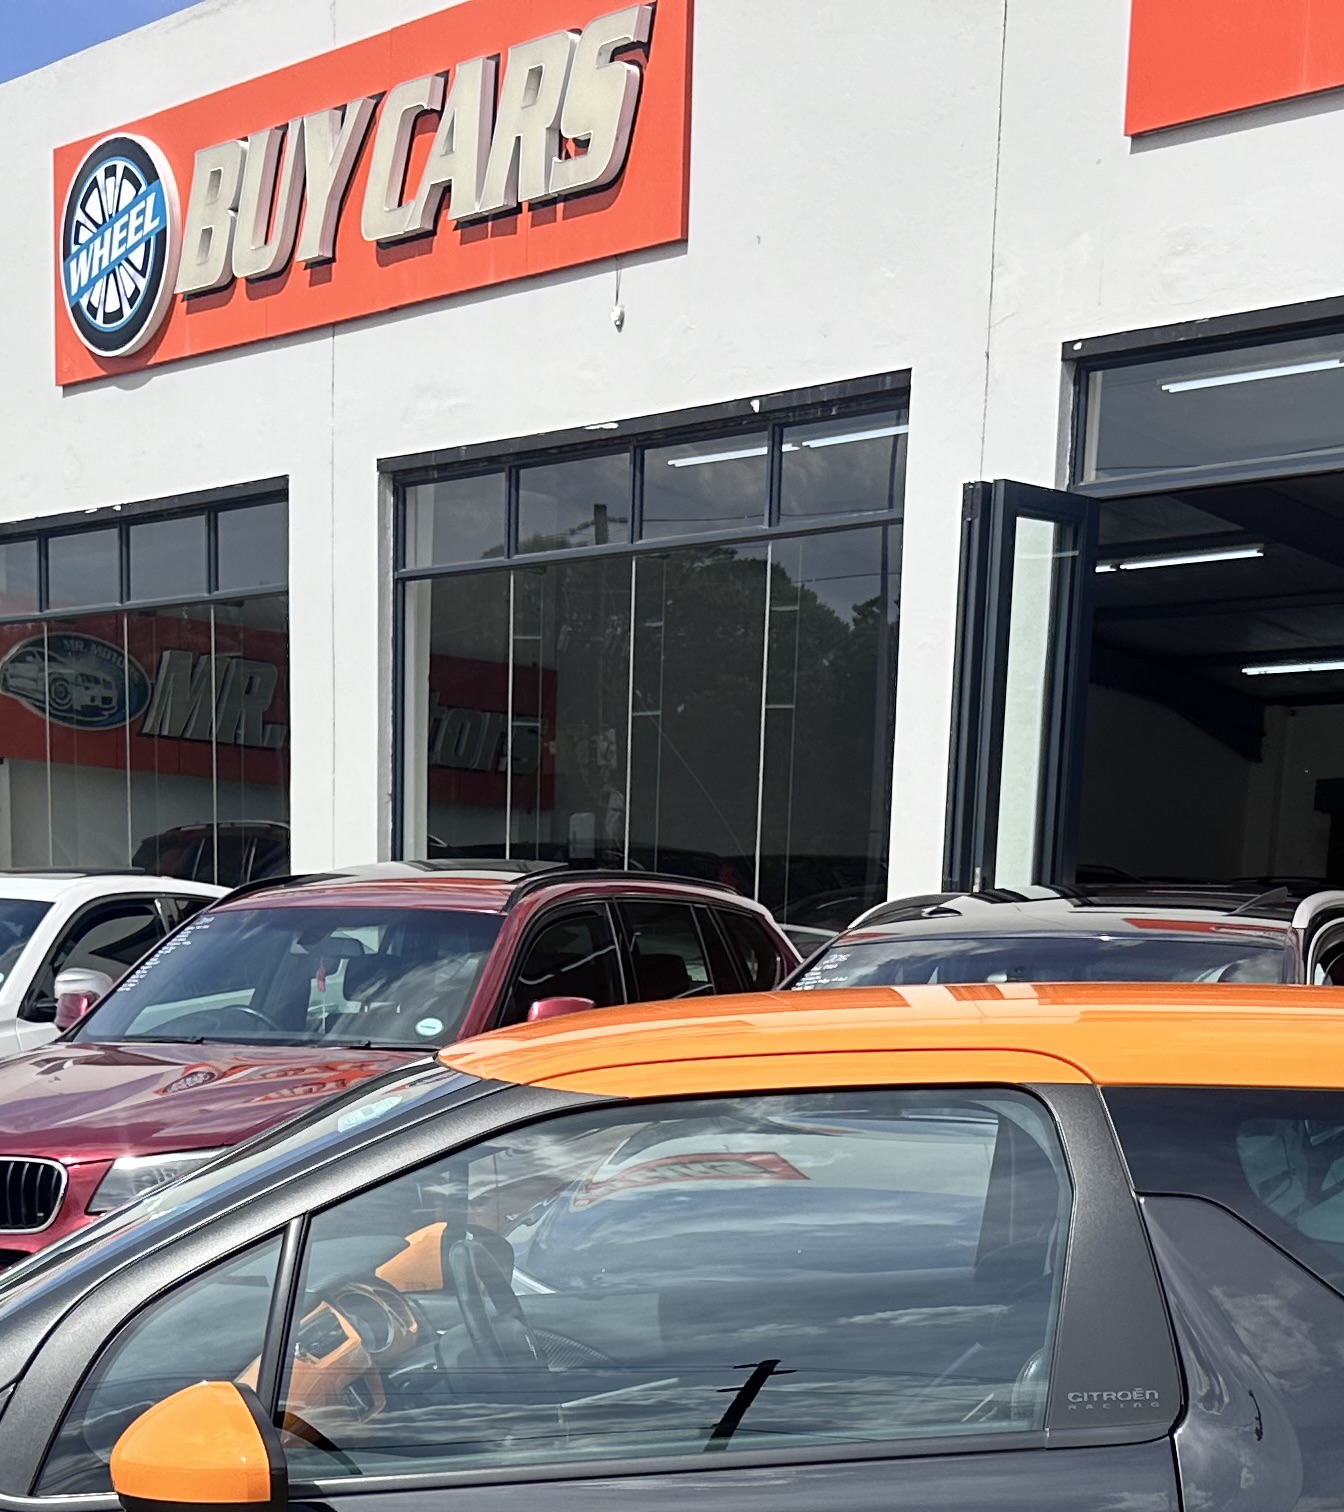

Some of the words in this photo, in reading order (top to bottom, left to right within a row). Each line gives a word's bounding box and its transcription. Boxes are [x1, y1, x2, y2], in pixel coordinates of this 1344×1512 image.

[174, 91, 384, 295] BUY
[360, 3, 656, 242] CARS
[67, 190, 160, 297] WHEEL
[141, 650, 288, 748] MR.
